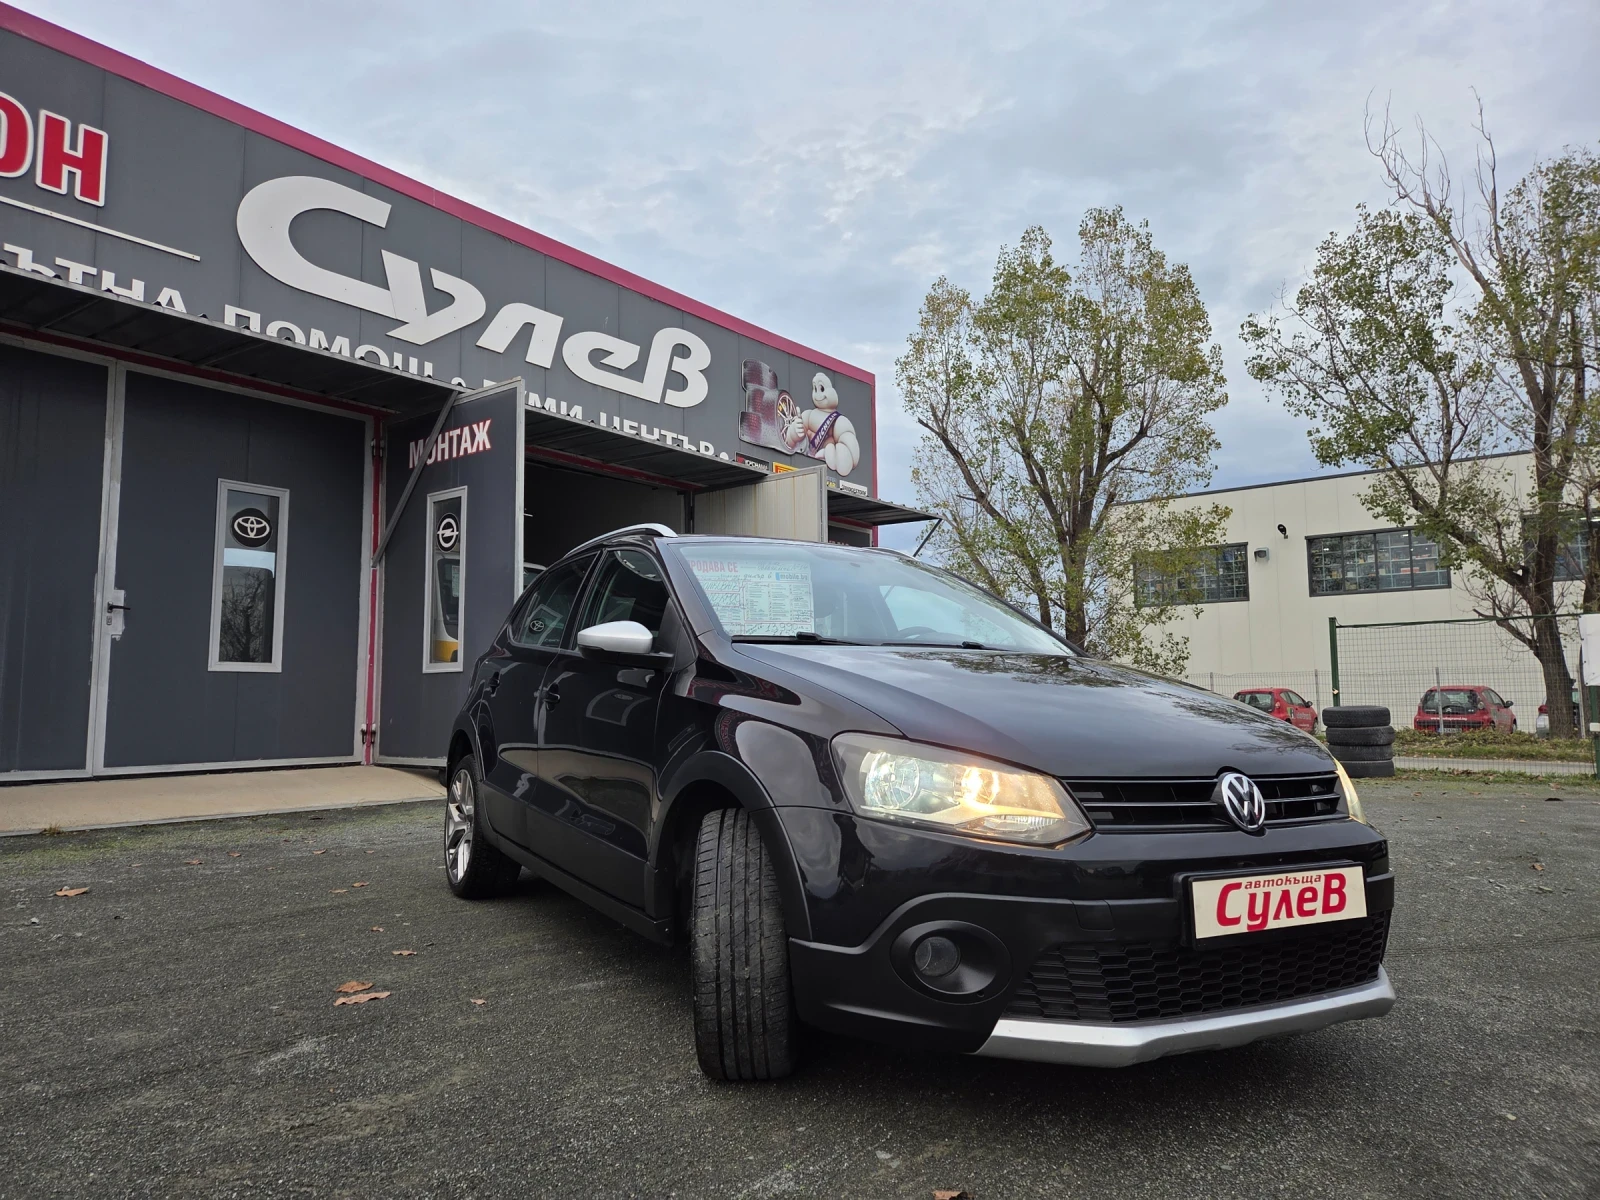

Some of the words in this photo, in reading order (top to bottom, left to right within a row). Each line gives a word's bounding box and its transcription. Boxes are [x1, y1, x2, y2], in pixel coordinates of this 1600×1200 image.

[686, 560, 726, 573] РОДАВА
[727, 560, 739, 573] СЕ
[1244, 874, 1322, 890] автокъща
